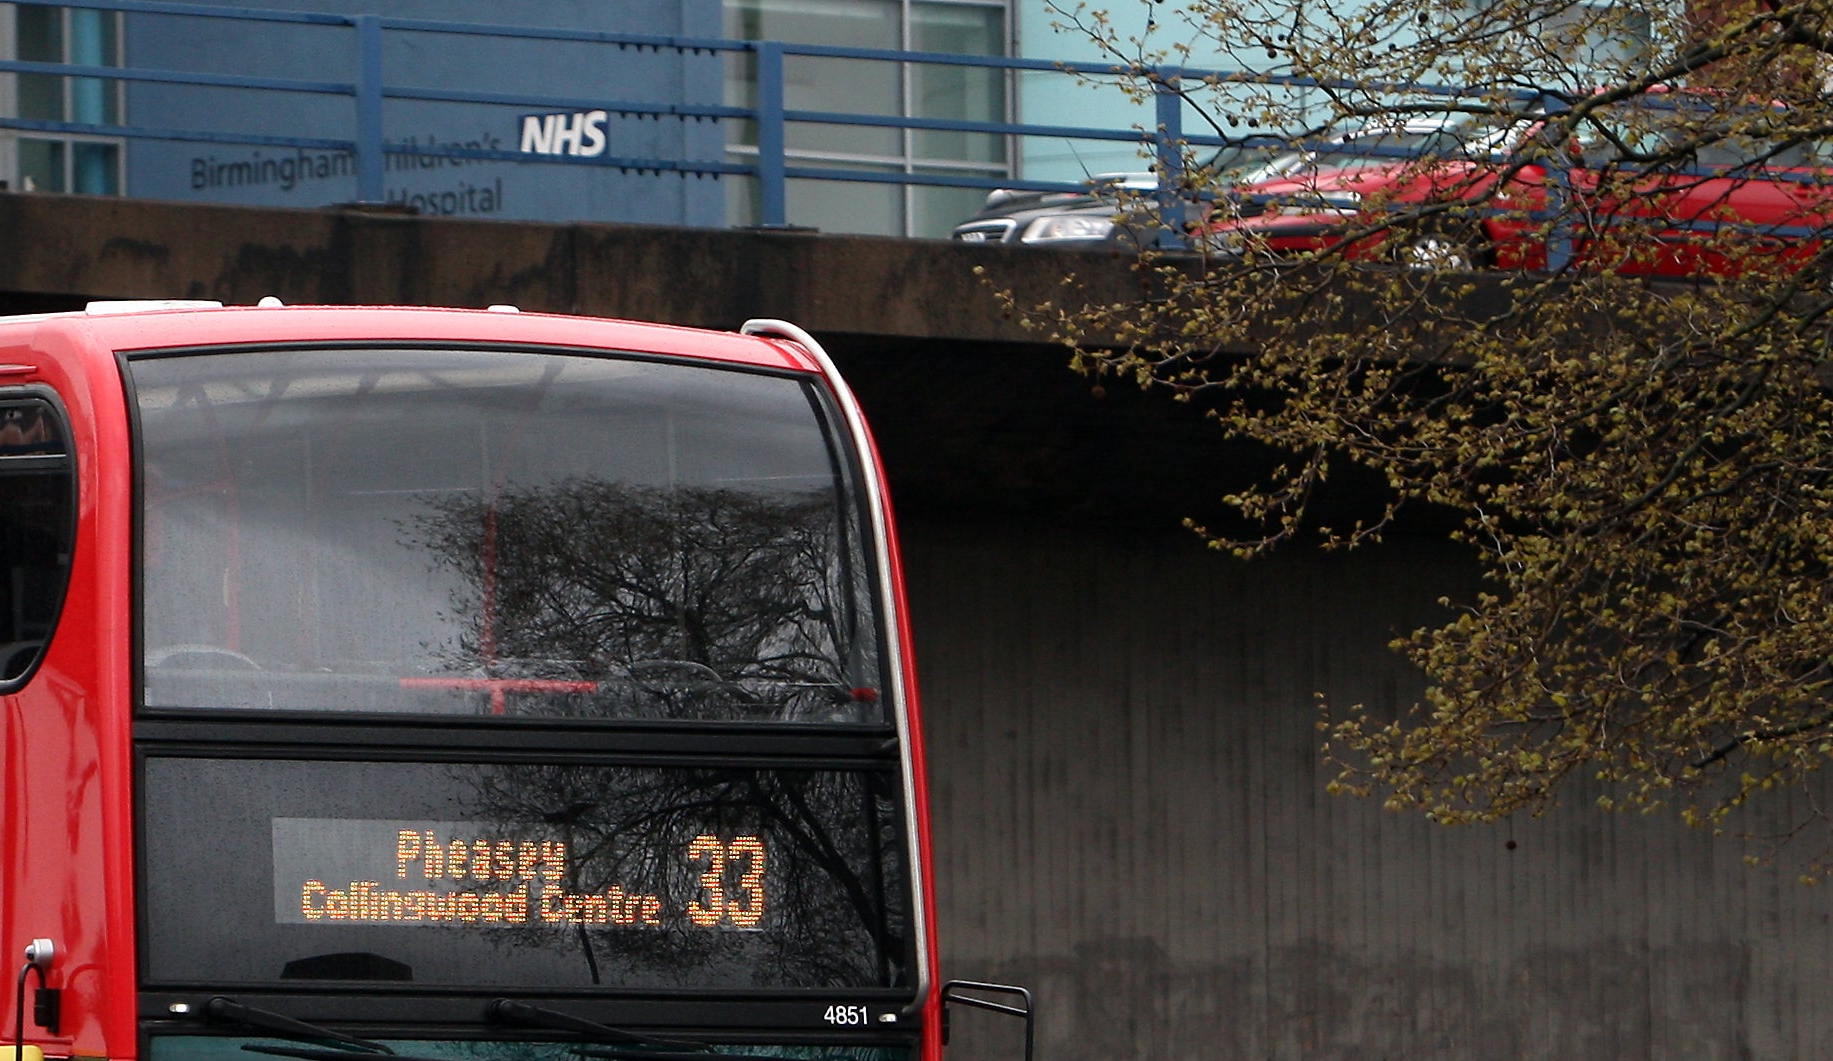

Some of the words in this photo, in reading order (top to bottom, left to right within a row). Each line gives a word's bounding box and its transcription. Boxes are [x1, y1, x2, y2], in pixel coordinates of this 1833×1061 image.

[520, 109, 608, 157] NHS
[191, 148, 359, 191] Birmingham
[383, 132, 502, 169] hildren's
[388, 178, 504, 216] Hospital
[396, 829, 566, 880] Pheasey
[301, 879, 529, 921] Collingwood
[541, 883, 663, 924] Centre
[688, 834, 765, 926] 33
[823, 1005, 868, 1025] 4851
